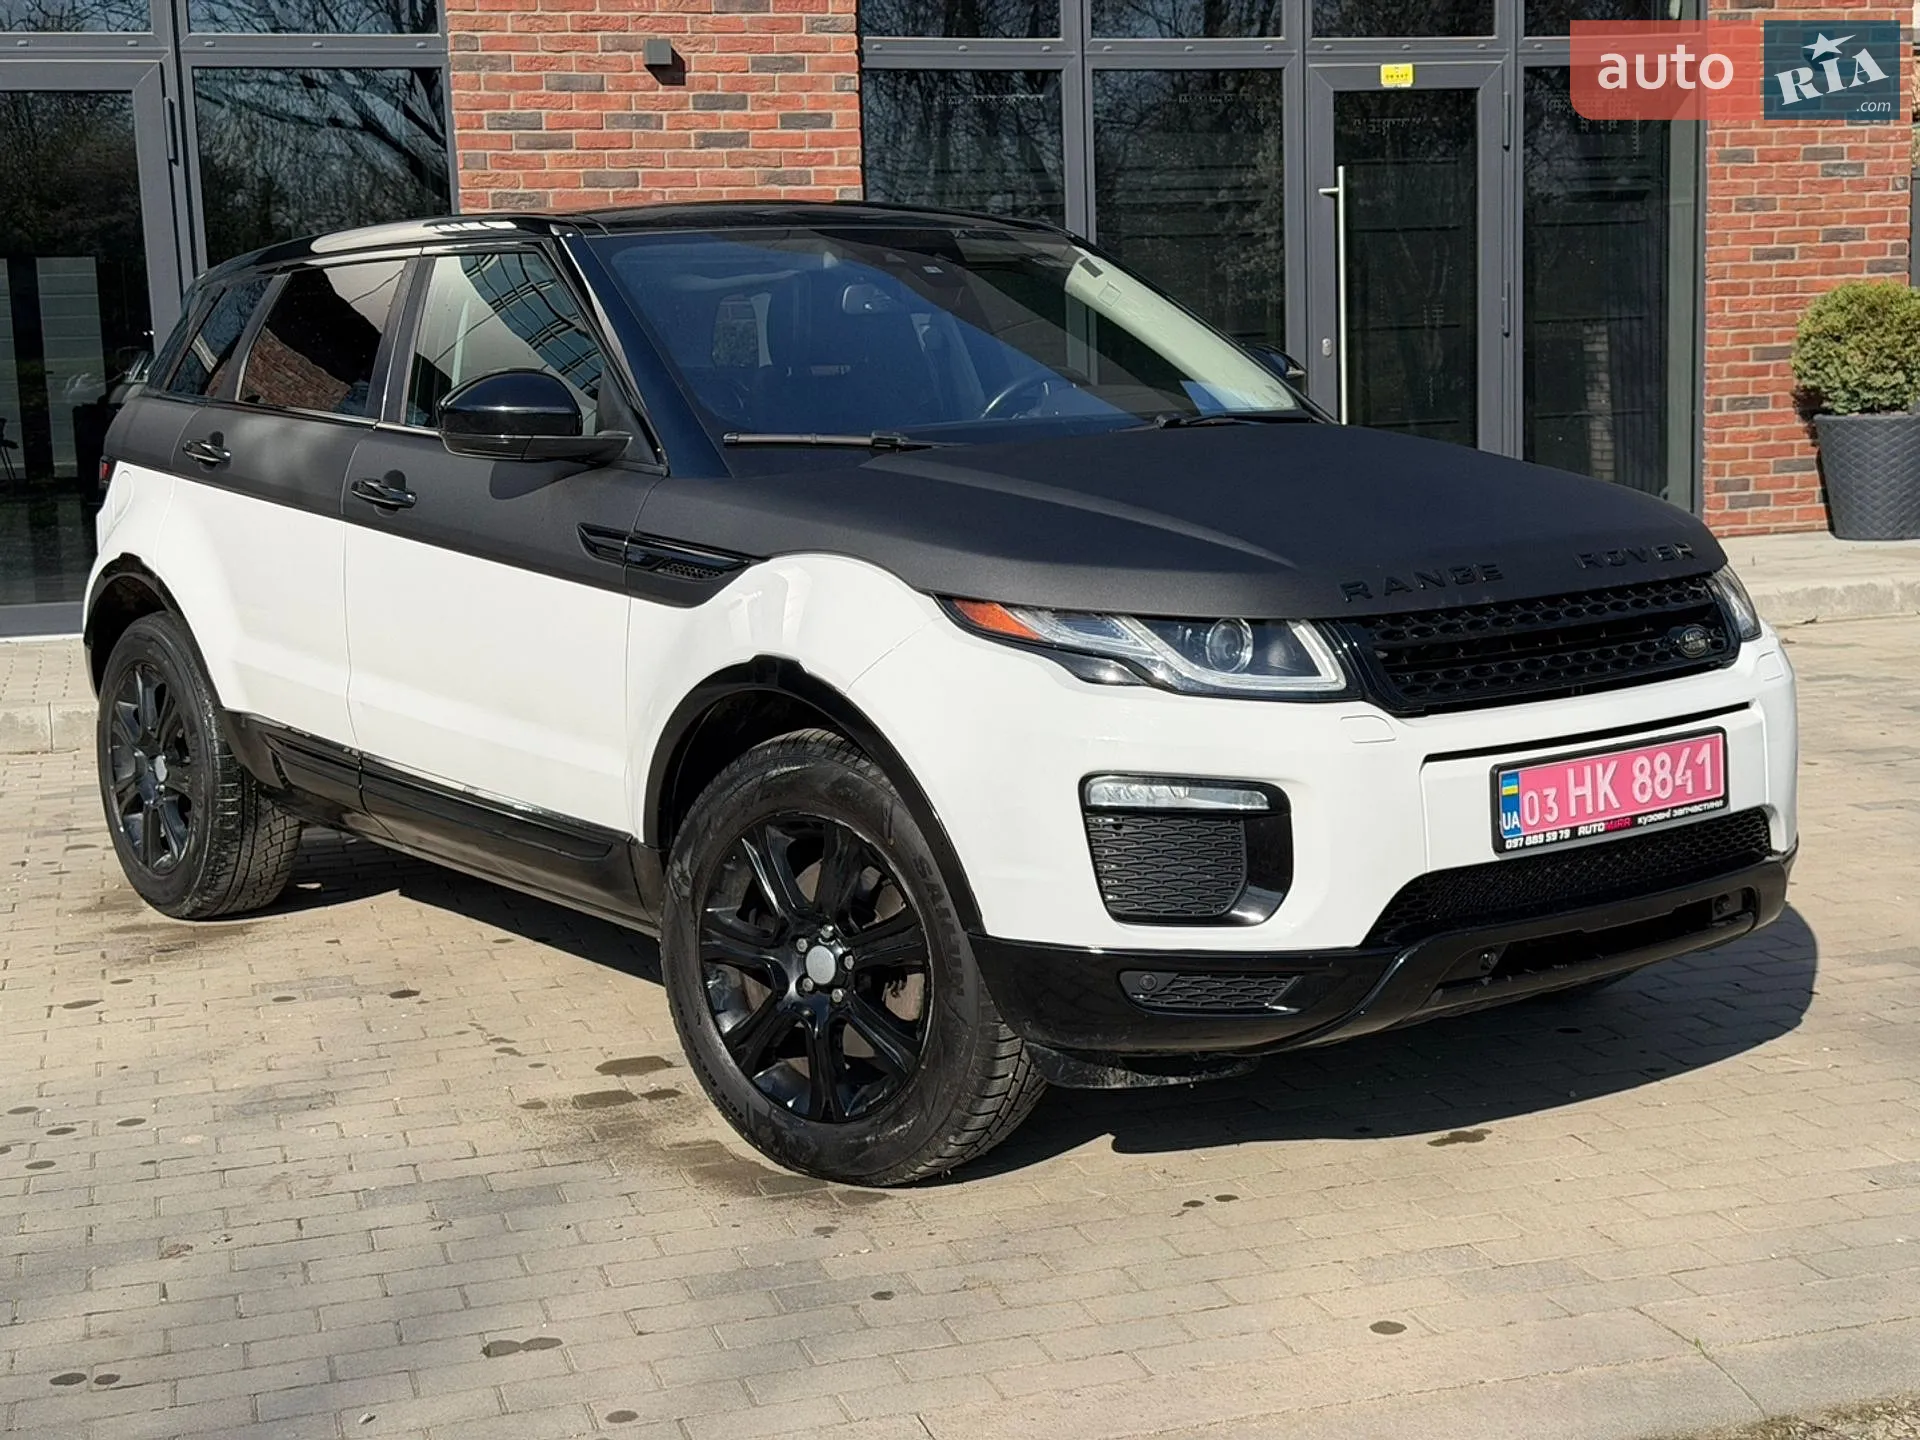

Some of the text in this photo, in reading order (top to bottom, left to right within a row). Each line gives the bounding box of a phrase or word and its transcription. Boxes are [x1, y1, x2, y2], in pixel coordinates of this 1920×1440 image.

[1339, 543, 1696, 602] RANGE ROVER
[1523, 743, 1713, 826] 03 HK 8841
[1502, 811, 1521, 831] UA
